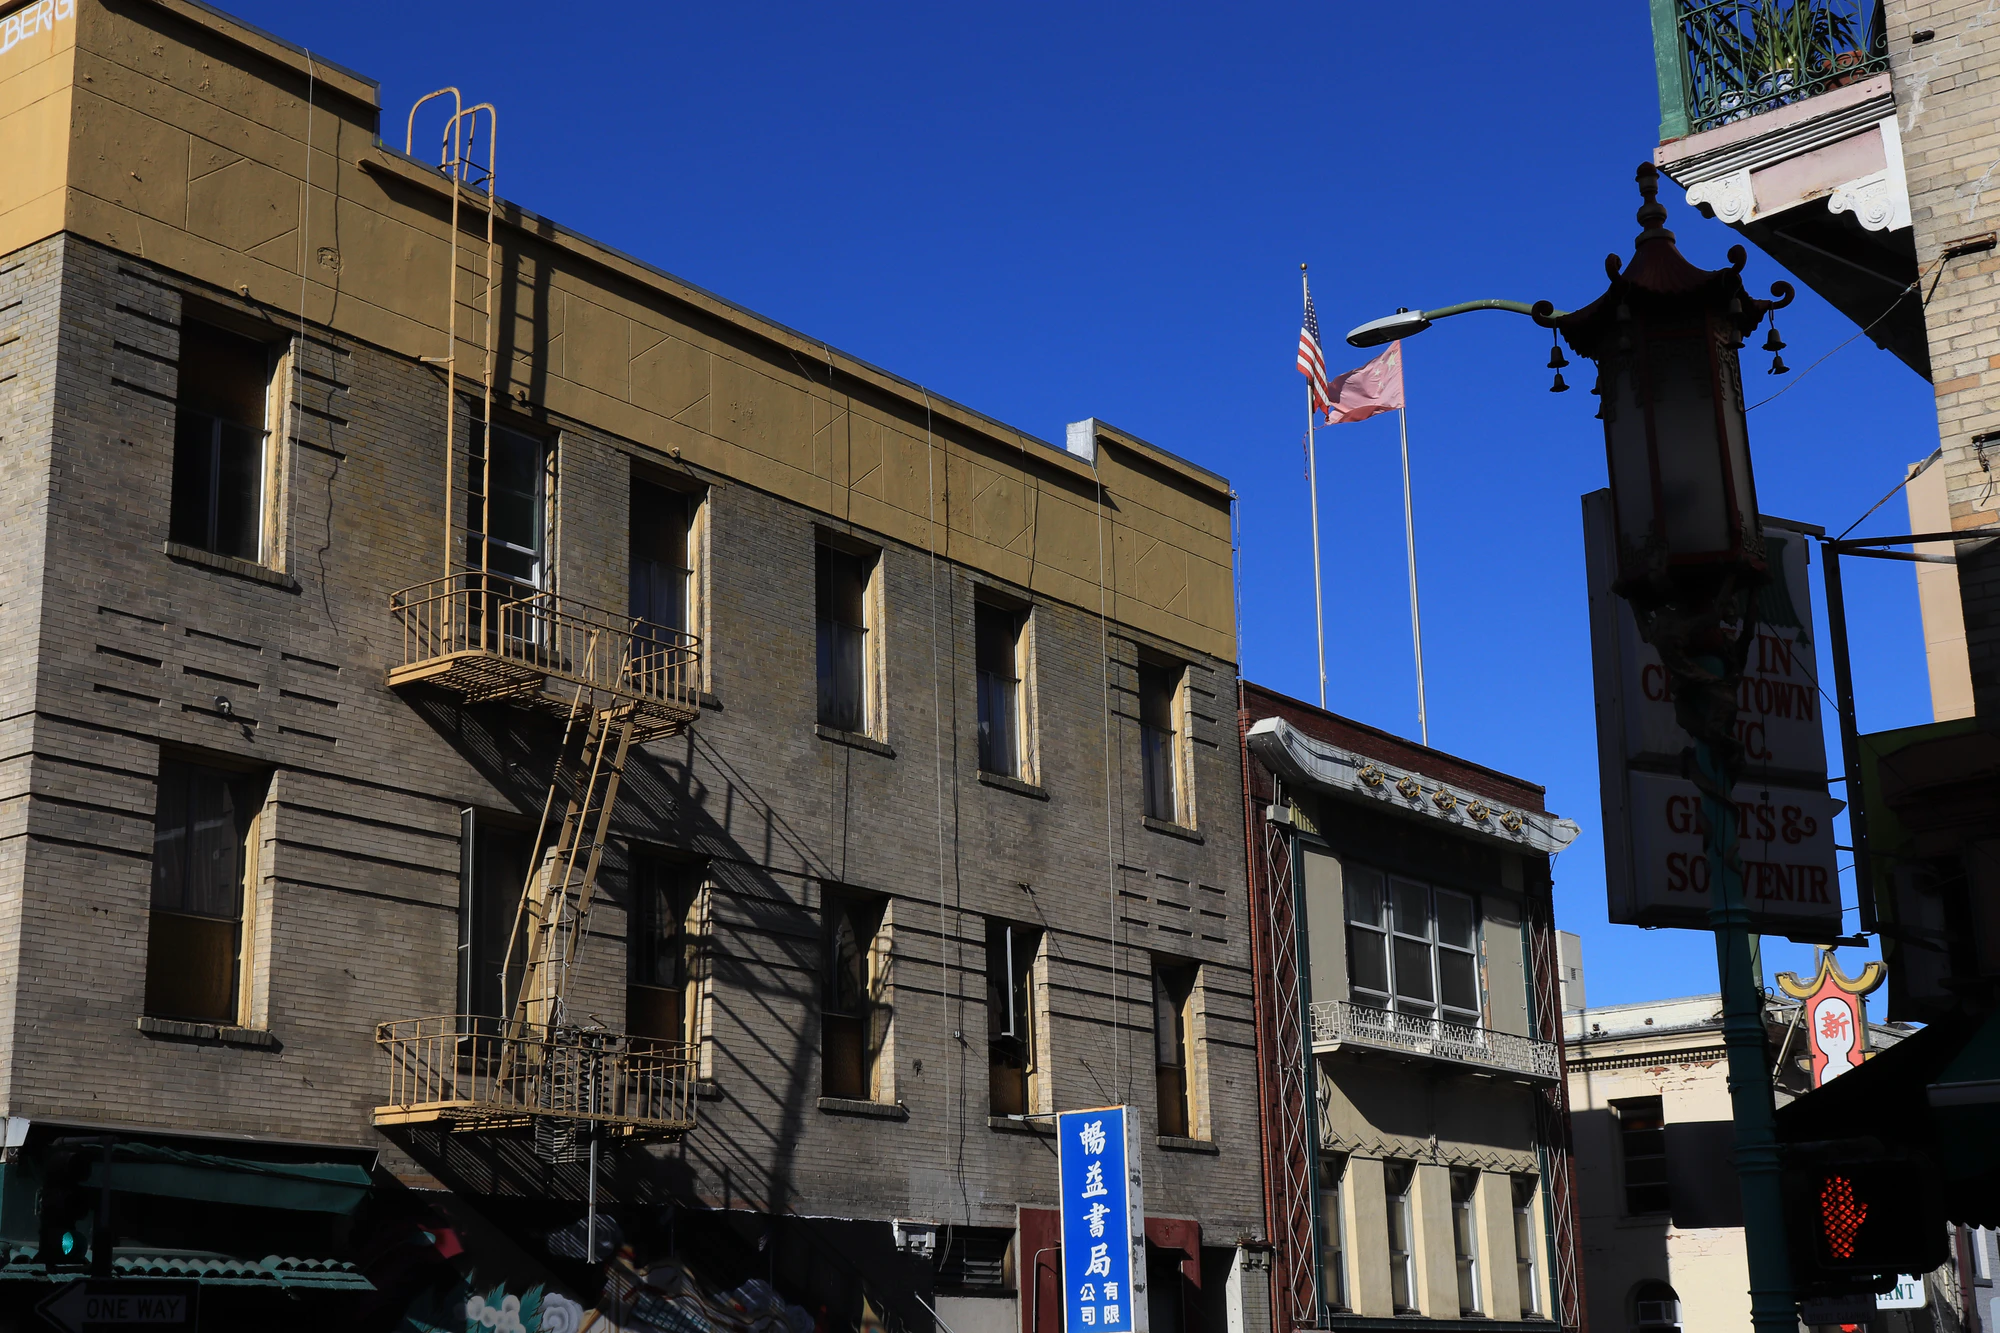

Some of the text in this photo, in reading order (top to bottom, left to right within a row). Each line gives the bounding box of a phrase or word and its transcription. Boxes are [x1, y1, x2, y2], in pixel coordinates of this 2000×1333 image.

[1781, 805, 1817, 845] &
[1666, 852, 1832, 905] SOVENIR
[1820, 1011, 1851, 1041] 新
[87, 1298, 180, 1319] ONE WAY
